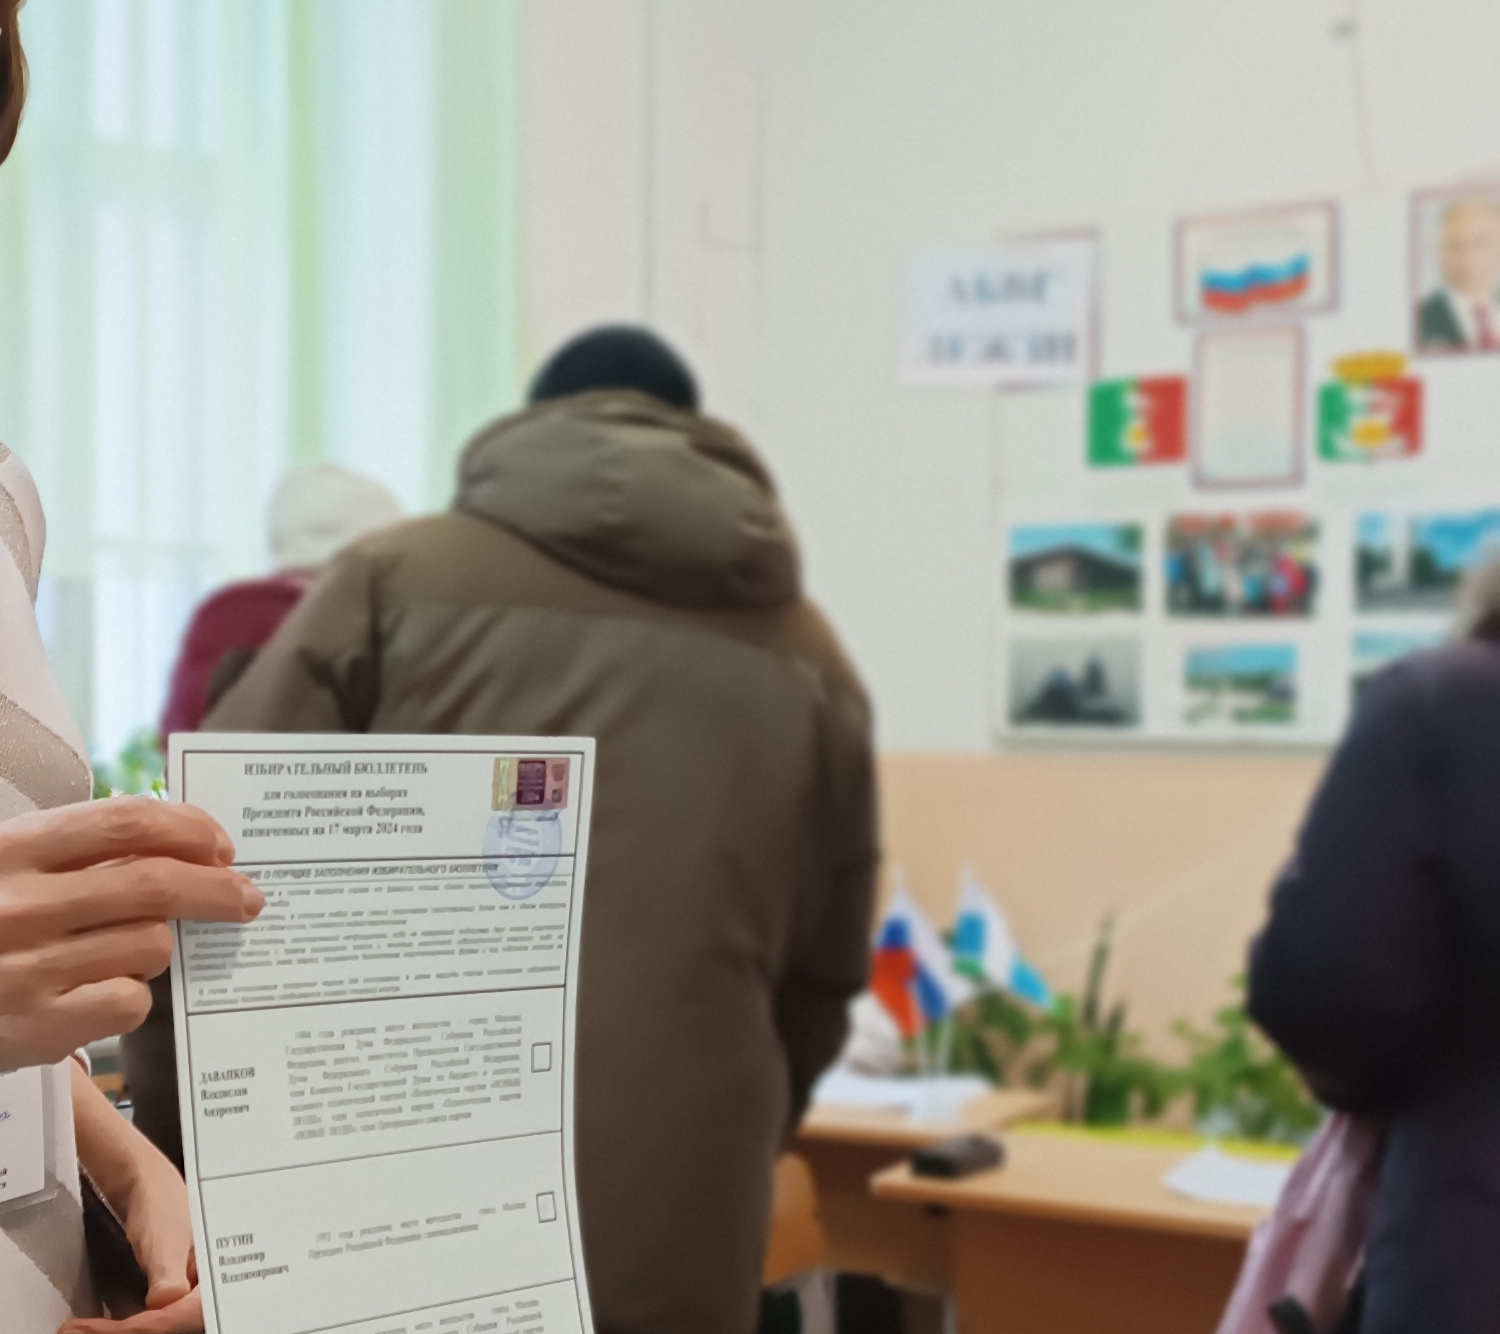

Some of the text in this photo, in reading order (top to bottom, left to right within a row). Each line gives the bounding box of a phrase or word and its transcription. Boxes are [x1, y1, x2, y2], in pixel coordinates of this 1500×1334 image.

[244, 760, 429, 776] ИЗБИРАТЕЛЬНЫЙ БЮЛЛЕТЕНЬ
[242, 807, 301, 822] Президента
[304, 805, 363, 818] Российской
[328, 823, 340, 835] 17
[343, 824, 373, 838] марта
[376, 822, 398, 835] 2024
[401, 823, 423, 834] года
[199, 1067, 255, 1085] ДАВАНКОВ
[216, 1233, 253, 1249] ПУТИН
